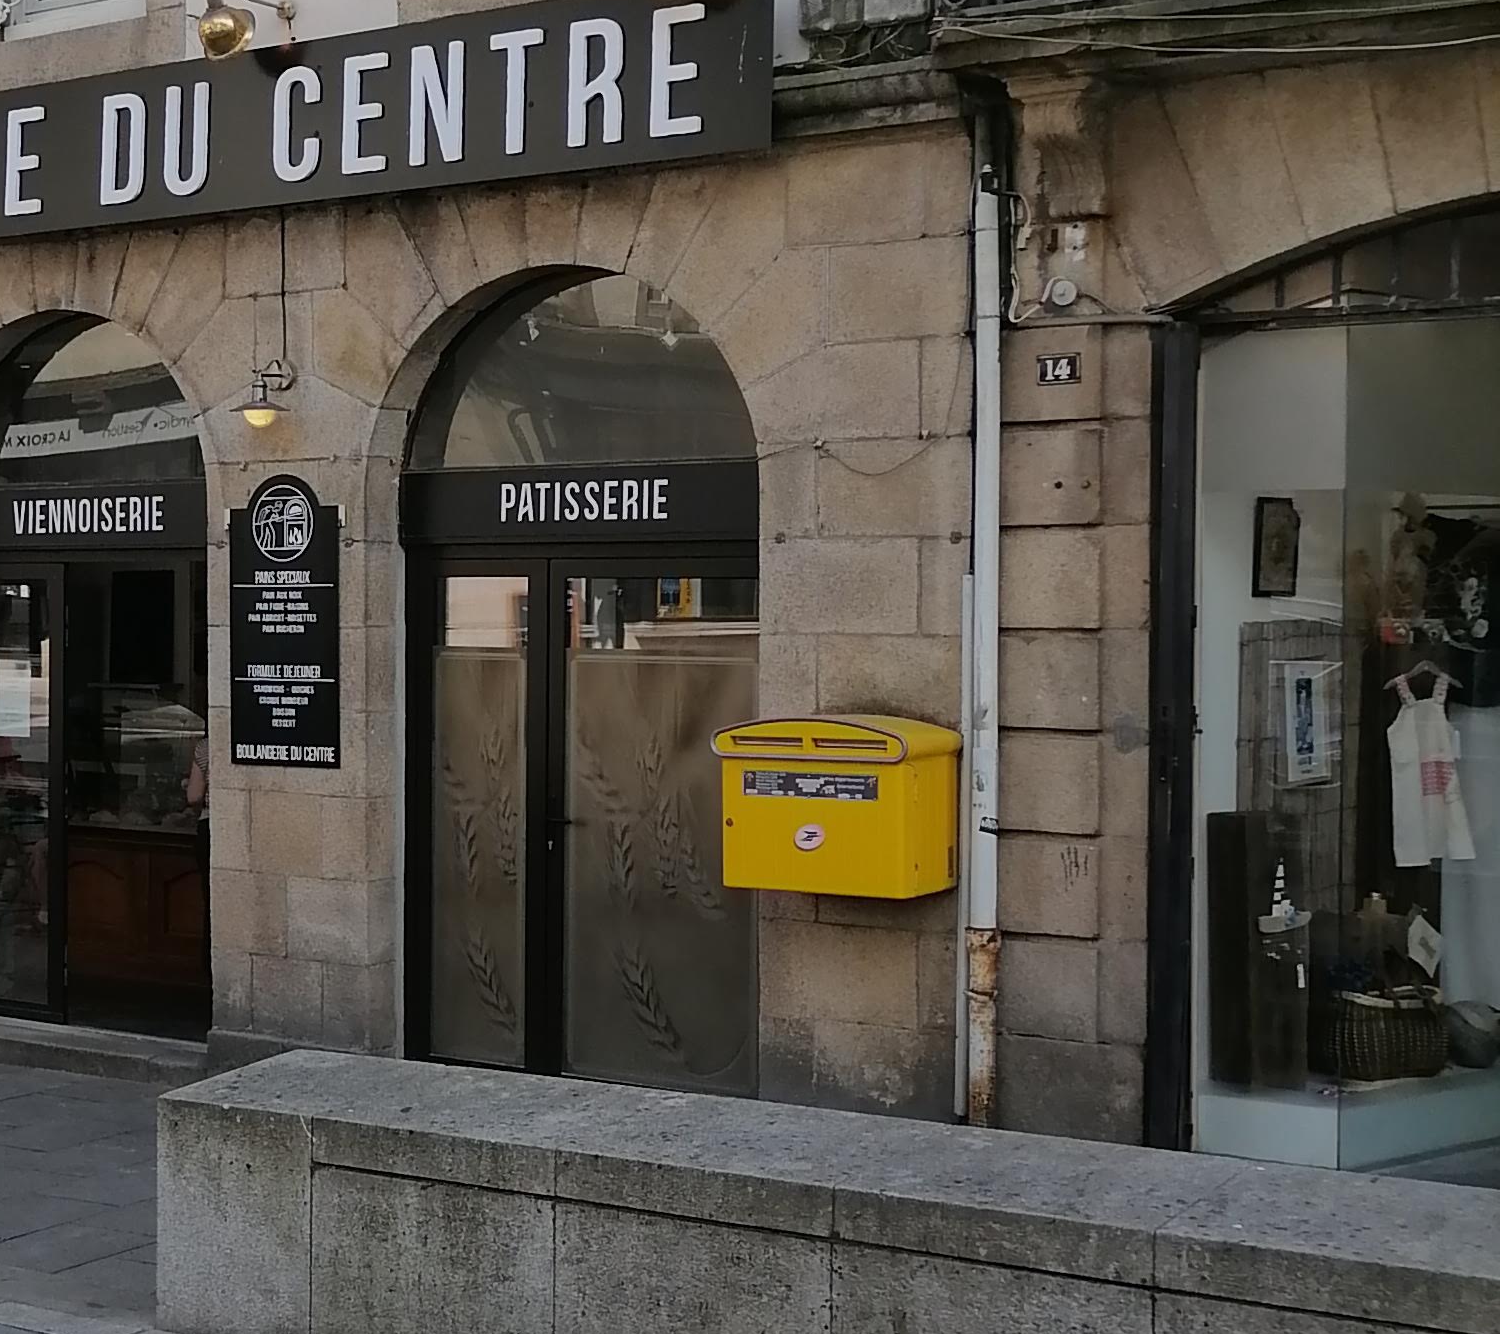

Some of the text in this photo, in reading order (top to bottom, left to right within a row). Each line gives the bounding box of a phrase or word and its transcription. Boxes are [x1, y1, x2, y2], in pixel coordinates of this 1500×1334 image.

[100, 80, 211, 206] DU
[271, 2, 706, 183] CENTRE
[1044, 358, 1071, 381] 14
[500, 478, 669, 523] PATISSERIE
[13, 495, 165, 536] VIENNOISERIE
[254, 570, 311, 584] PAINS SPECIAUX
[247, 664, 322, 679] FORMULE DEJEUNER
[236, 743, 336, 763] BOULANGERIE DU CENTRE
